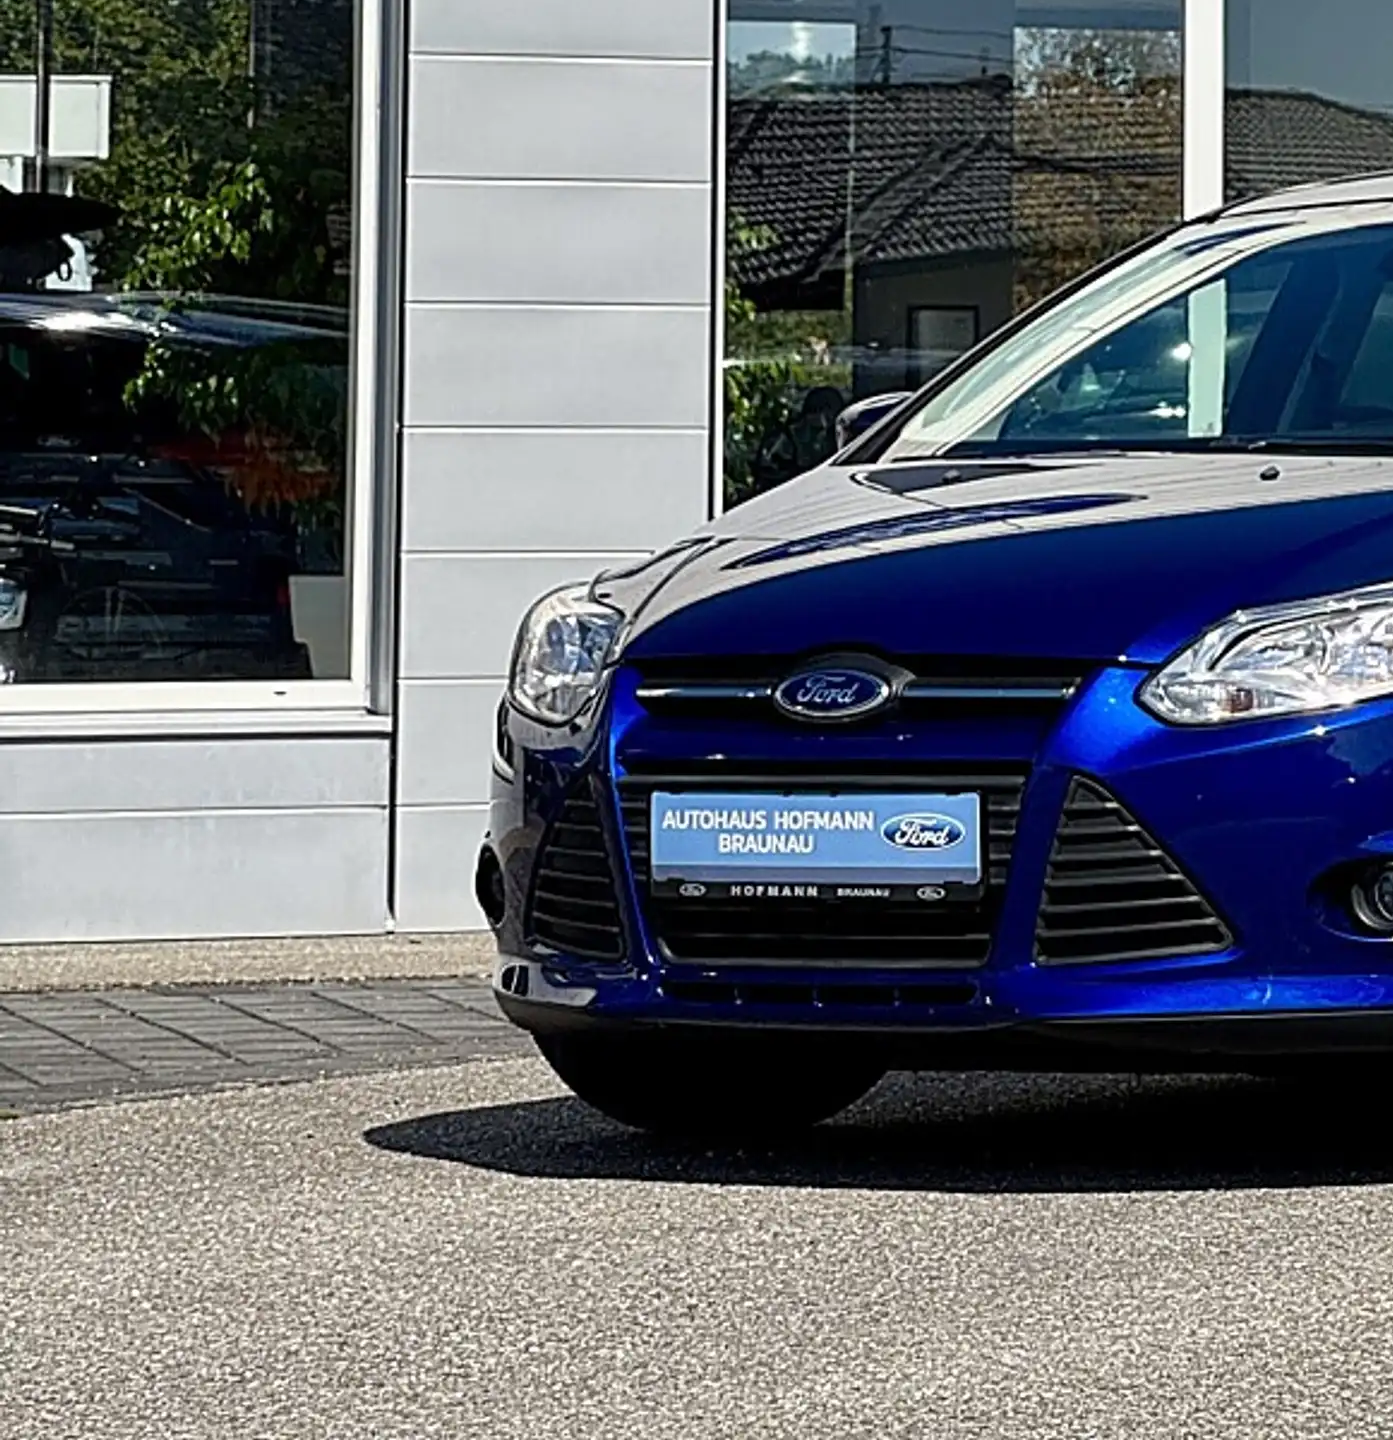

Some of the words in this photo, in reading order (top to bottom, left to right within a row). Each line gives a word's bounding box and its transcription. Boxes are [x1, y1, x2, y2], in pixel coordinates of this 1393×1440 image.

[796, 674, 860, 704] Ford
[662, 810, 767, 830] AUTOHAUS
[774, 810, 874, 831] HOFMANN
[894, 817, 950, 845] Ford
[718, 833, 814, 854] BRAUNAU
[730, 885, 818, 898] HOFMANN
[837, 887, 890, 898] BRAUNAU
